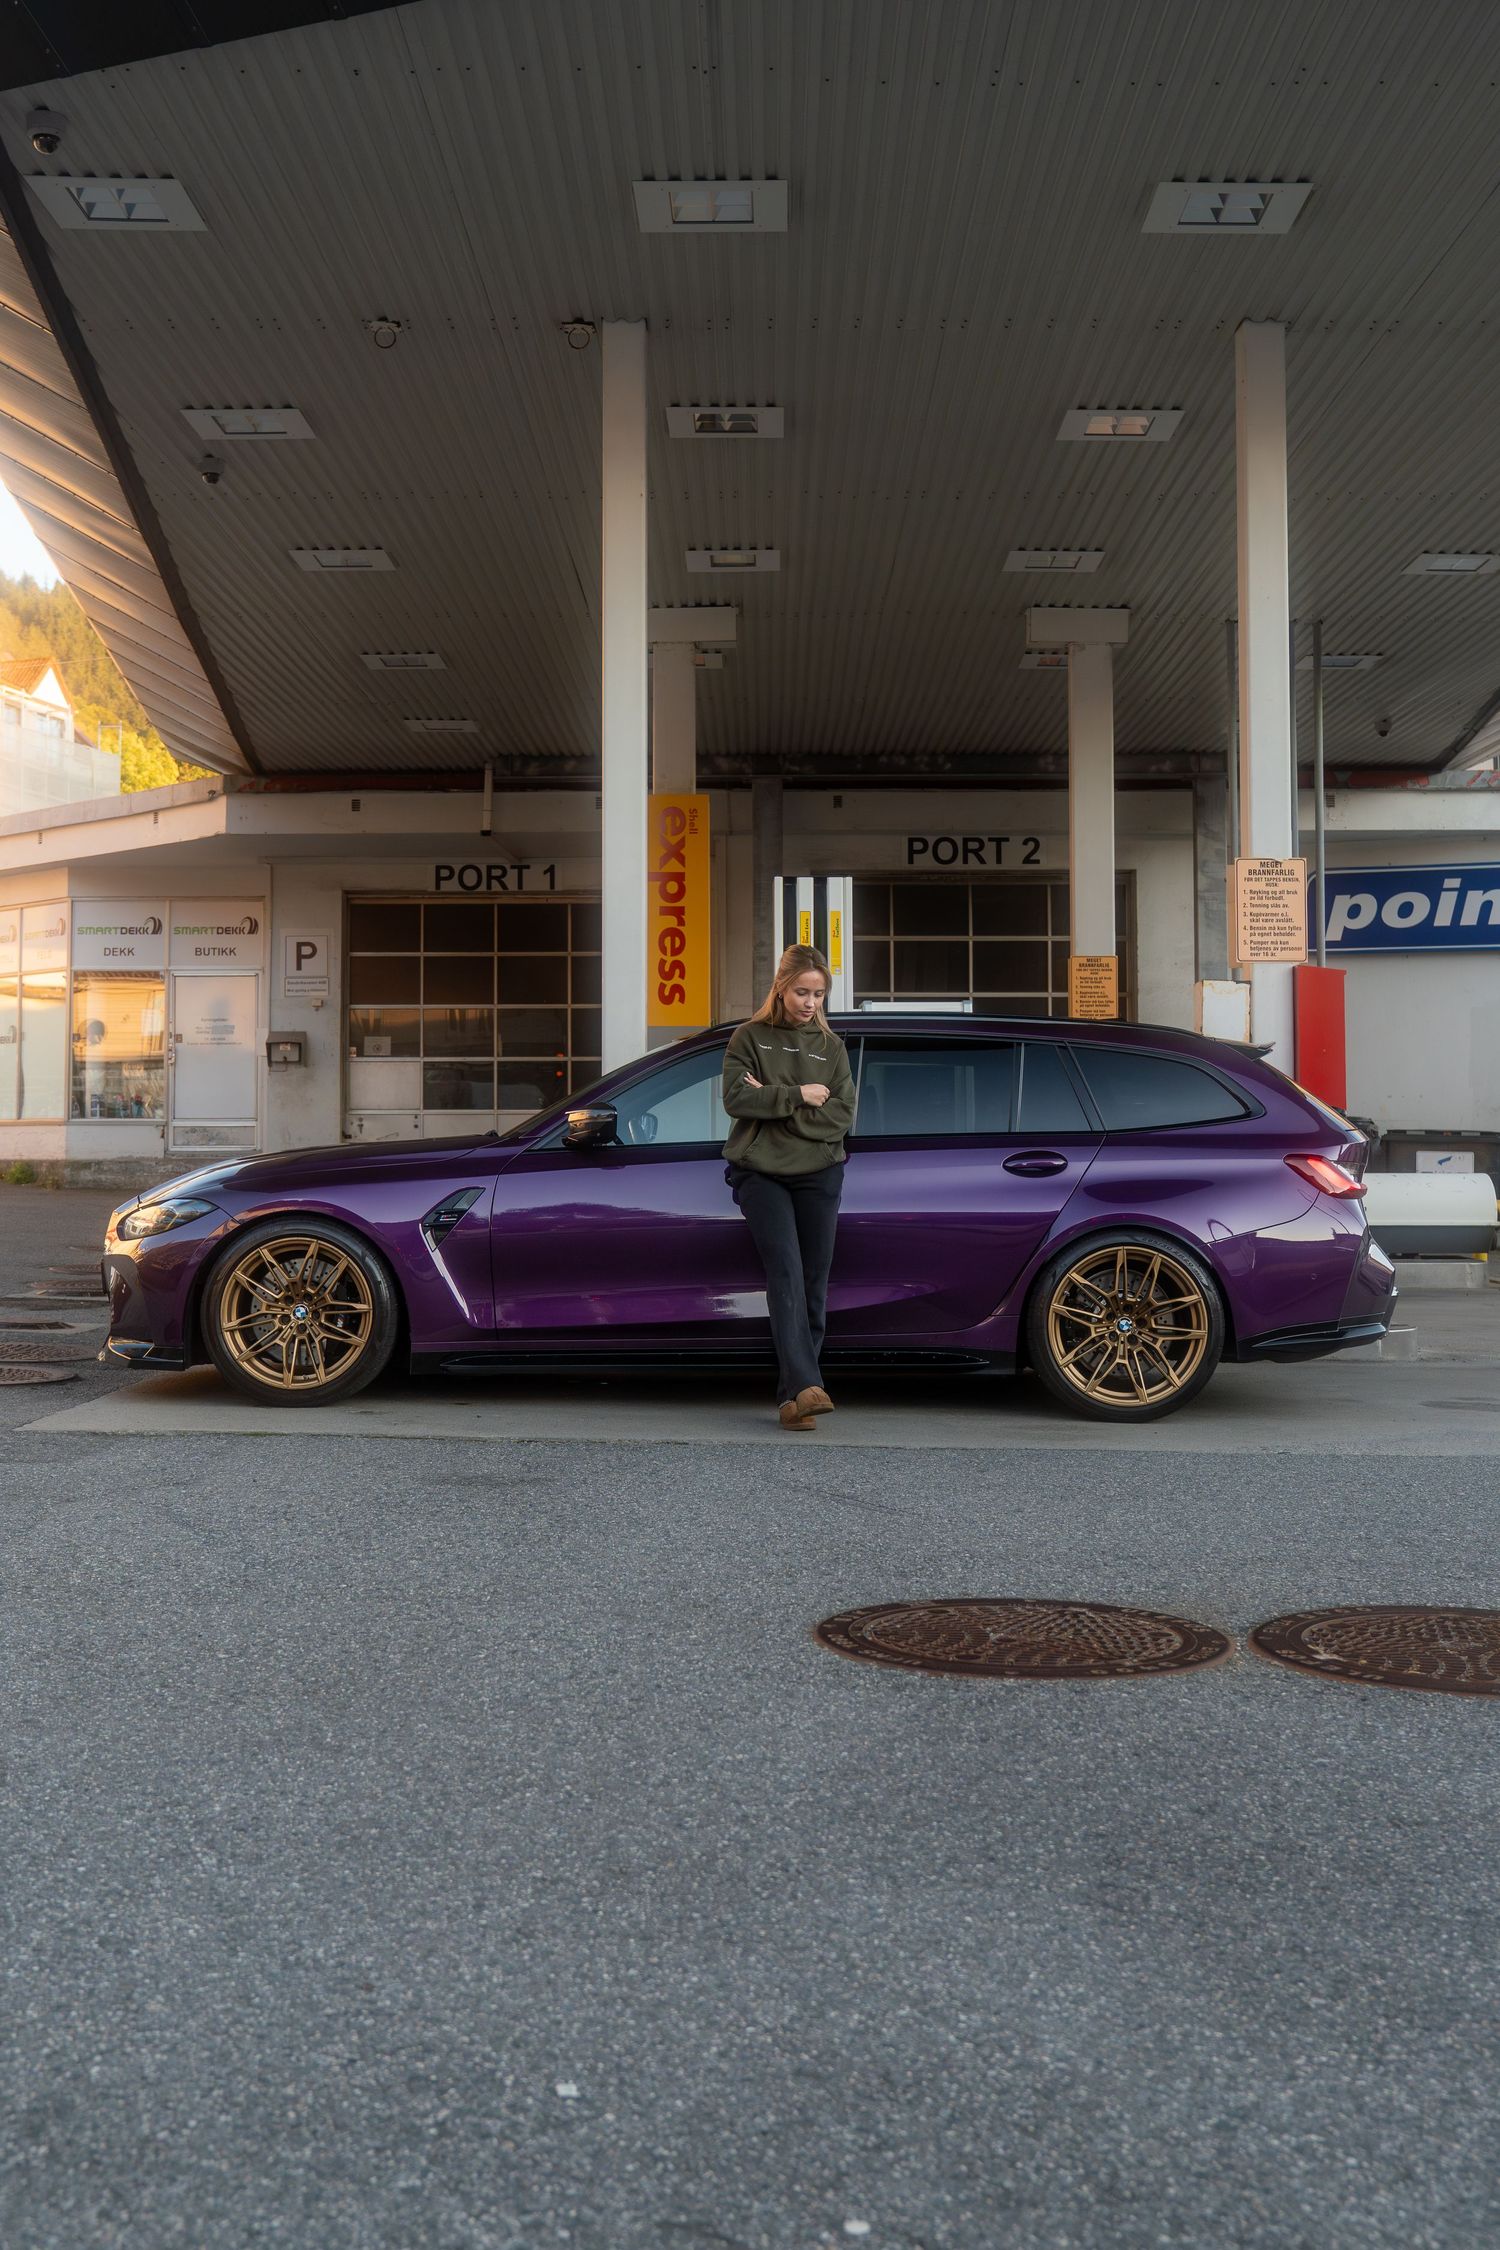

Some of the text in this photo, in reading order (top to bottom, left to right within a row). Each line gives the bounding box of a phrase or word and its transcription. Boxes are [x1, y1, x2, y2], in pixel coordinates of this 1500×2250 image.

[689, 807, 699, 835] Shell
[907, 836, 1041, 865] PORT 2
[434, 864, 556, 891] PORT 1
[647, 806, 687, 1006] express
[1325, 878, 1500, 942] poin
[77, 926, 150, 935] SMARTDEKK
[173, 926, 246, 935] SMARTDEKK
[103, 947, 136, 957] DEKK
[194, 947, 237, 957] BUTIKK
[296, 941, 318, 971] P
